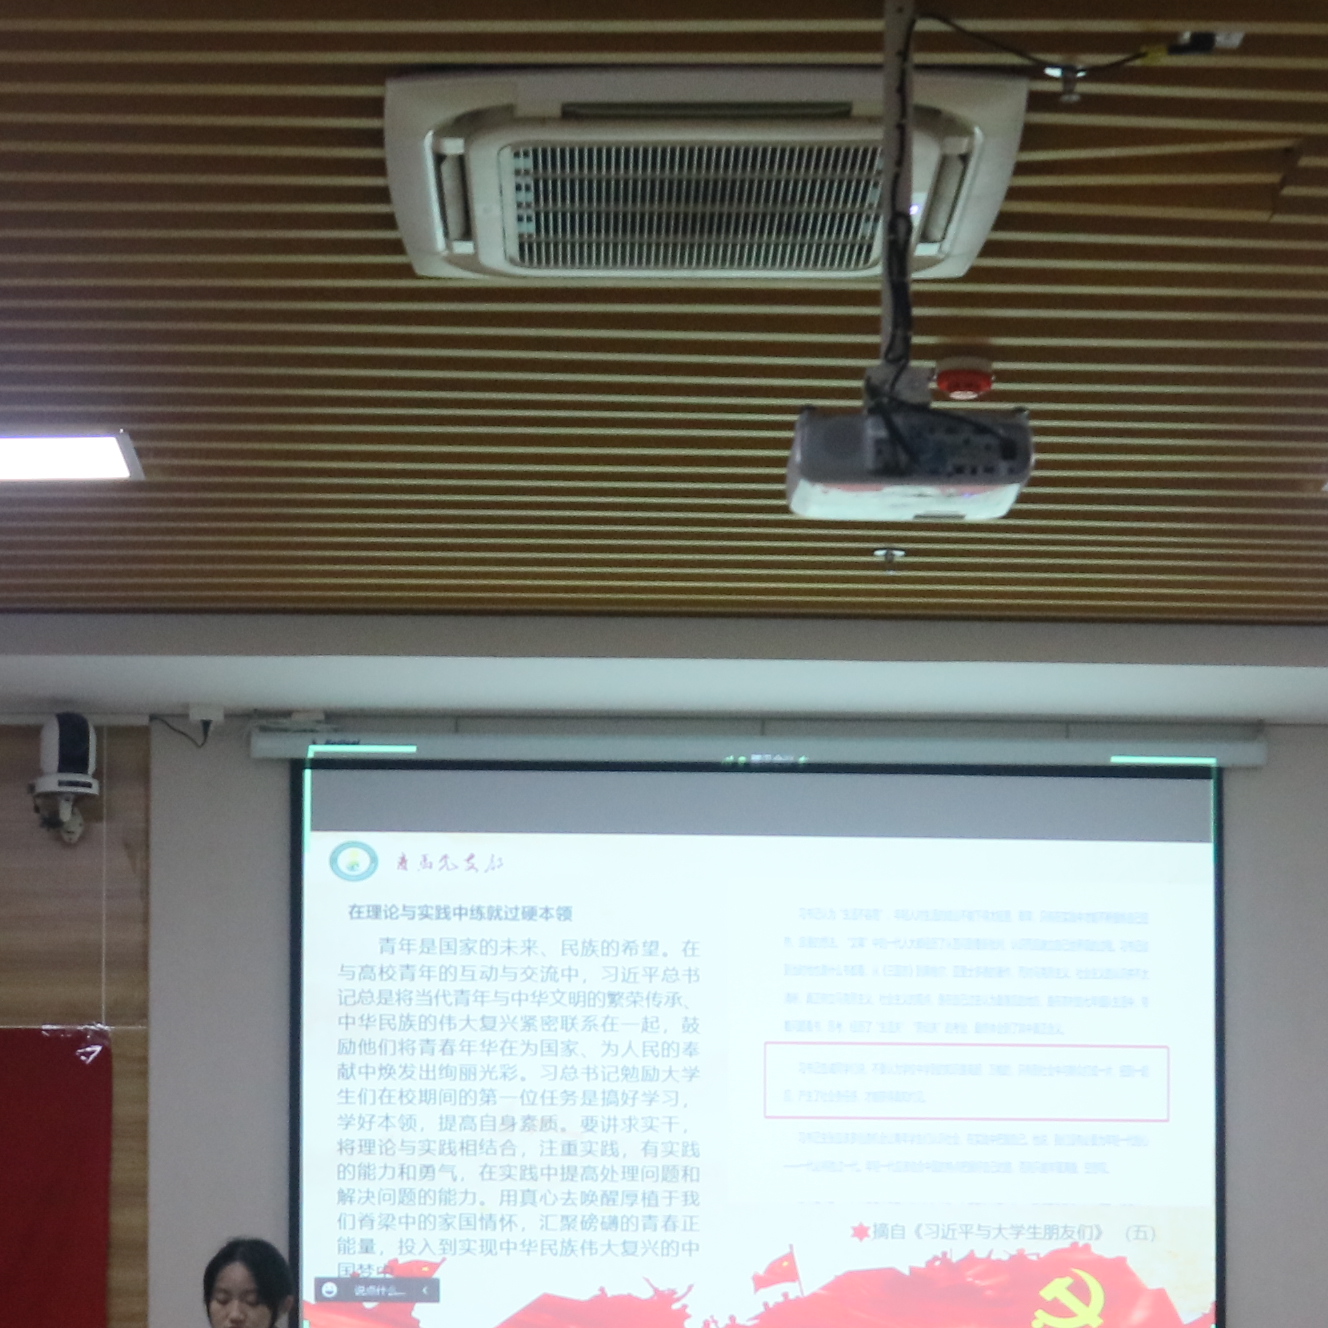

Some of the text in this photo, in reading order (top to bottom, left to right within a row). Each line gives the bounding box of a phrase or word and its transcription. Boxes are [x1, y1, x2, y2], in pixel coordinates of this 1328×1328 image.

[348, 903, 573, 923] 在理论与实践中练就过硬本领
[378, 936, 700, 959] 青年是国家的未来、民族的希望。在
[338, 963, 700, 985] 与高校青年的互动与交流中，习近平总书
[338, 988, 692, 1010] 记总是将当代青年与中华文明的繁荣传承、
[337, 1012, 700, 1035] 中华民族的伟大复兴紧密联系在一起，鼓
[337, 1037, 700, 1059] 励他们将青春年华在为国家、为人民的奉
[337, 1087, 689, 1109] 生们在校期间的第一位任务是搞好学习，
[338, 1112, 689, 1134] 学好本领，提高自身素质。要讲求实干，
[337, 1137, 700, 1159] 将理论与实践相结合，注重实践，有实践
[337, 1162, 700, 1183] 的能力和勇气，在实践中提高处理问题和
[337, 1186, 700, 1208] 解决问题的能力。用真心去唤醒厚植于我
[337, 1211, 700, 1233] 们脊梁中的家国情怀，汇聚磅礴的青春正
[337, 1236, 700, 1258] 能量，投入到实现中华民族伟大复兴的中
